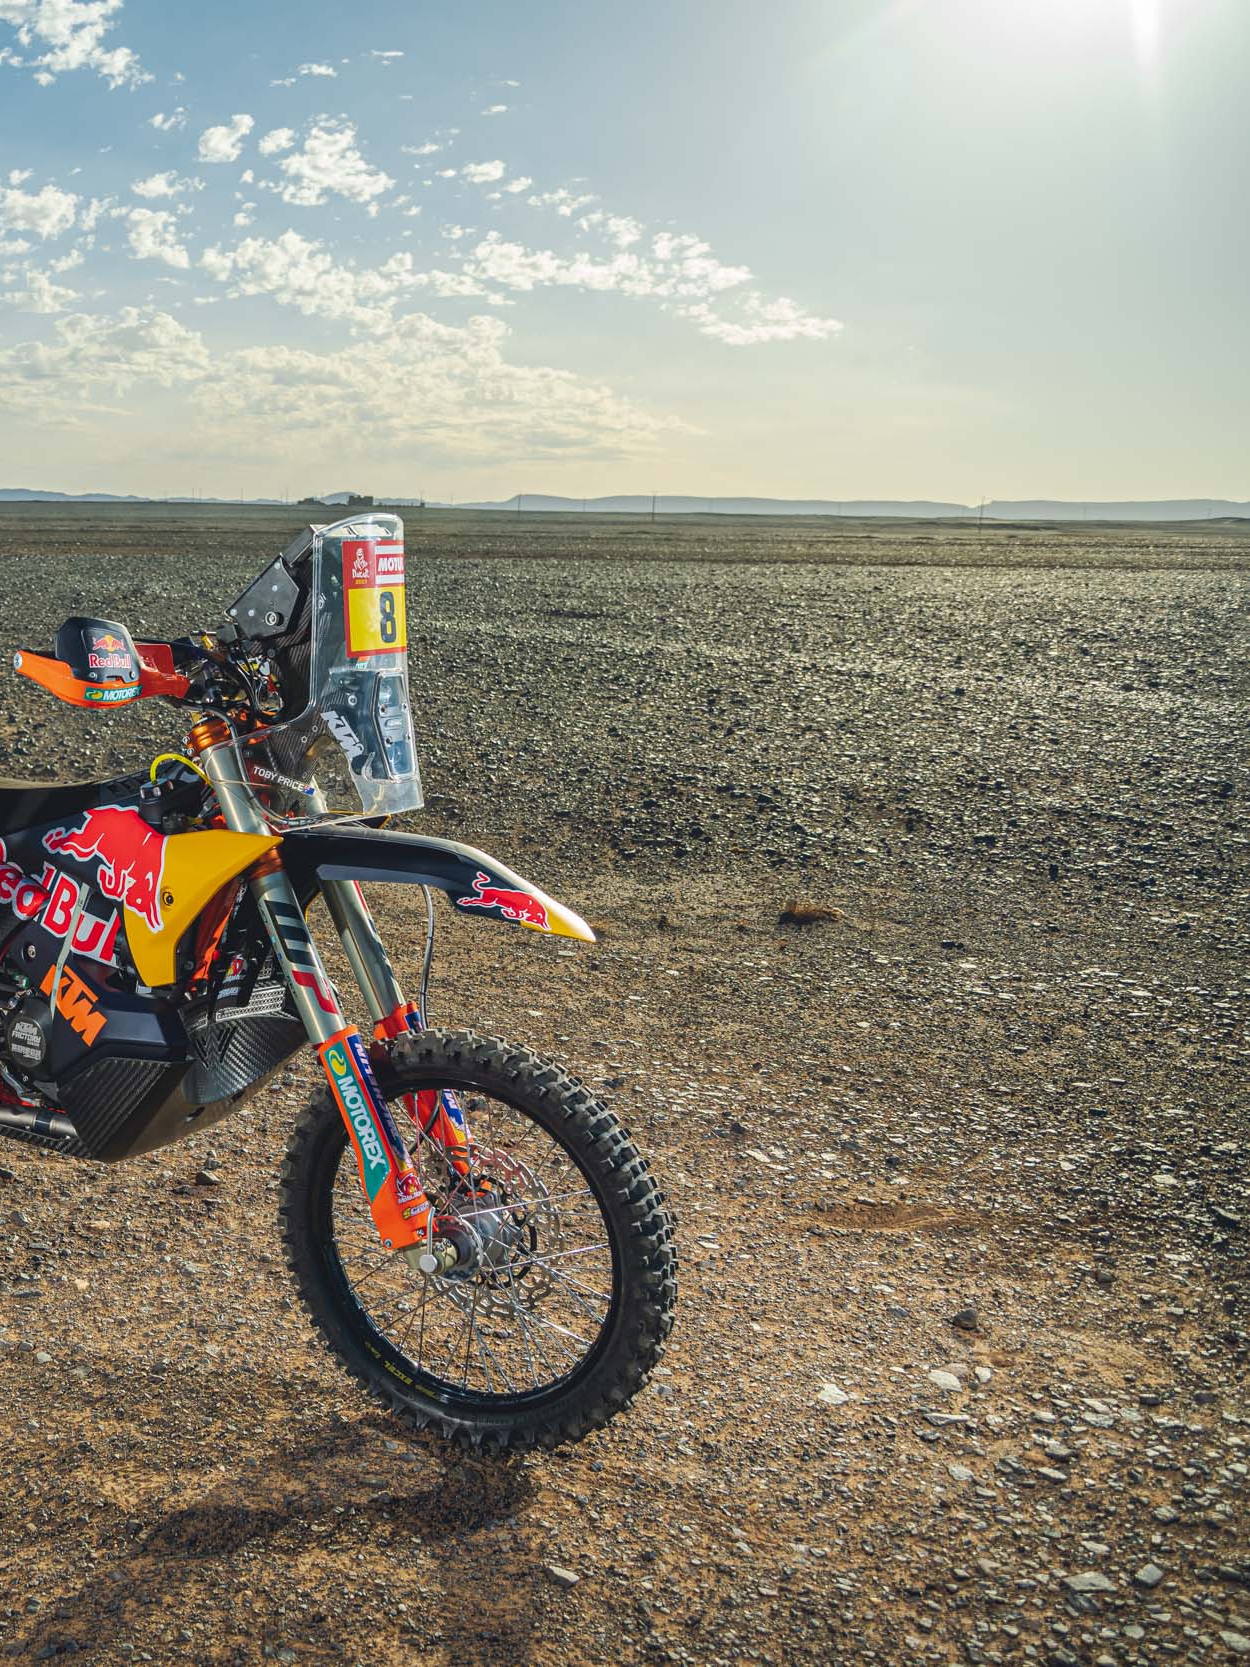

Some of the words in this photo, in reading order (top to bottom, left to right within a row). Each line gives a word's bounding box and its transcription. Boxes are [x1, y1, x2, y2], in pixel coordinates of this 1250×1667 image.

[378, 557, 404, 572] MOTU
[380, 591, 397, 644] 8
[88, 652, 110, 669] Red
[110, 653, 132, 669] Bull
[102, 686, 142, 701] MOTOREX
[320, 710, 363, 760] KTM
[253, 765, 279, 781] TOBY
[278, 775, 305, 792] PRICE
[40, 871, 122, 969] Bul
[40, 964, 107, 1048] KTM
[337, 1076, 386, 1170] MOTOREX
